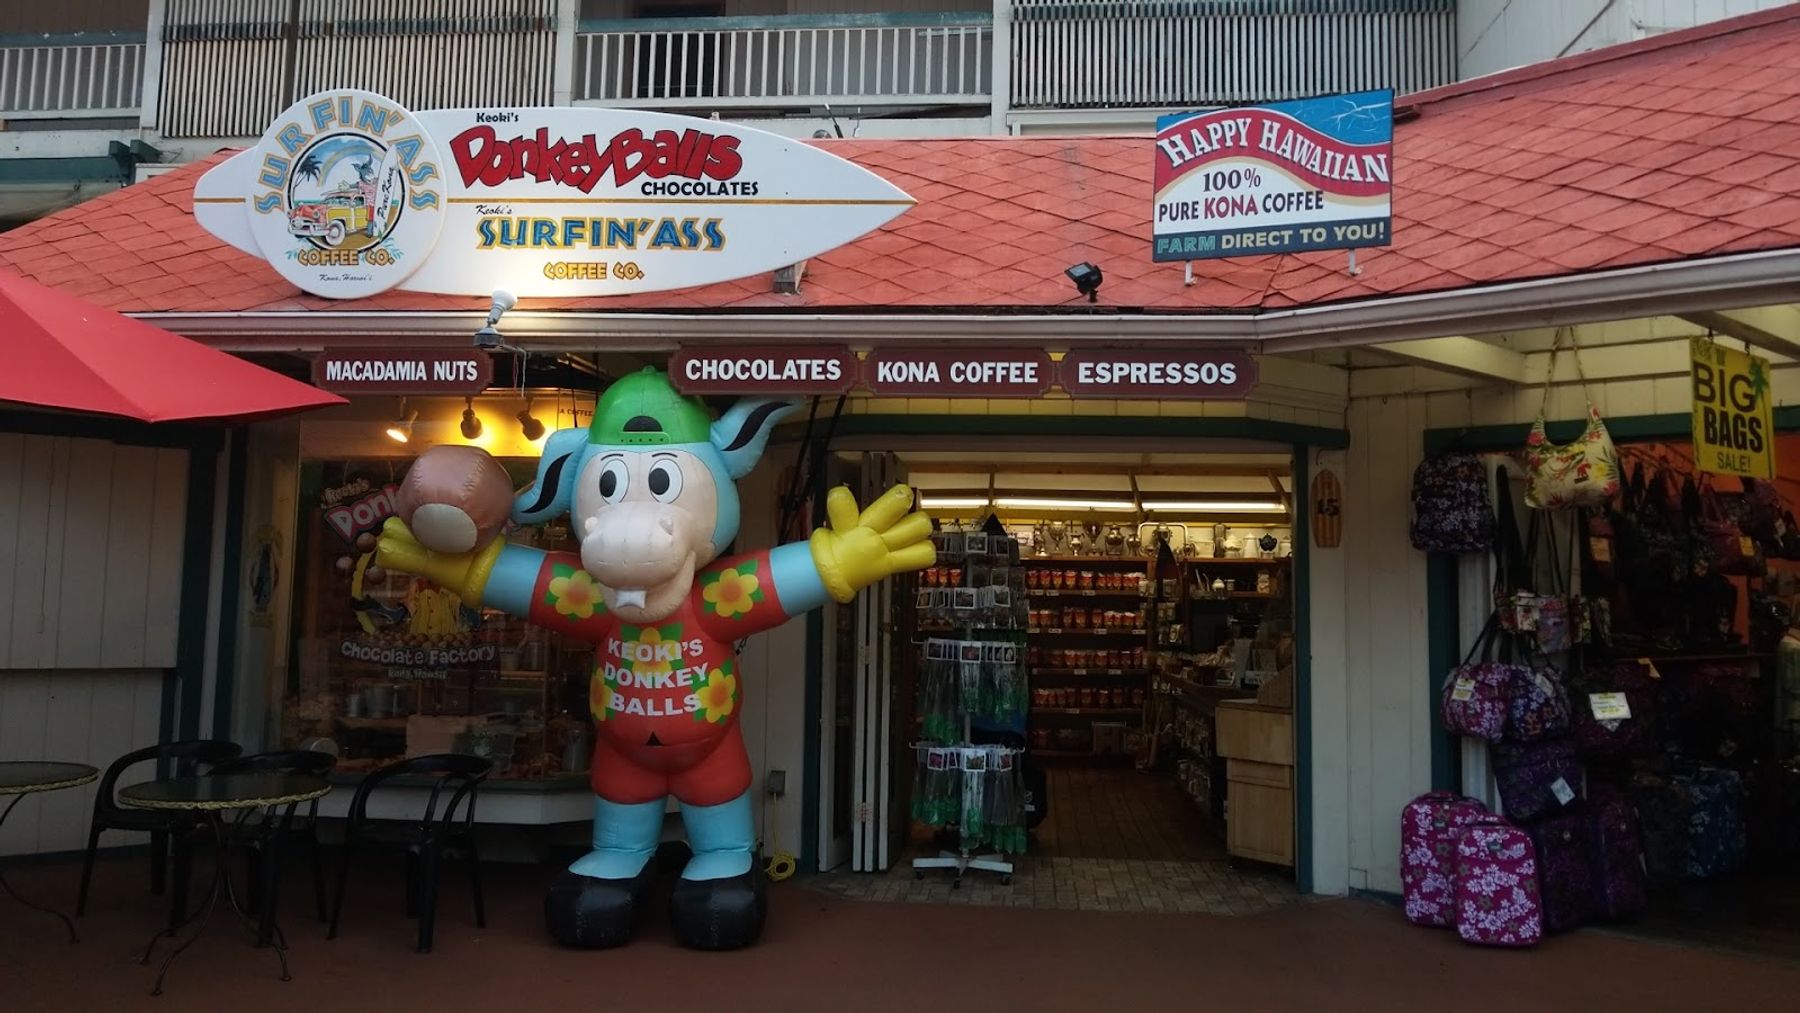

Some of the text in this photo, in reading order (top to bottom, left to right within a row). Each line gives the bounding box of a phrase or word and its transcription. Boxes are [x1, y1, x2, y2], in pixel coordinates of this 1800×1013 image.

[476, 112, 519, 123] Keoki's
[1156, 118, 1390, 183] HAPPY HAWAIIAN
[641, 181, 758, 196] CHOCOLATES
[1203, 167, 1261, 192] 100%
[475, 204, 513, 216] Keoki's
[1159, 190, 1324, 222] PURE KONA COFFEE
[1157, 221, 1385, 254] FARM DIRECT TO YOU!
[298, 249, 396, 266] COFFEE CO.
[543, 262, 645, 280] COFFEE CO.
[326, 359, 478, 382] MACADAMIA NUTS
[685, 358, 842, 382] CHOCOLATES
[877, 361, 1039, 384] KONA COFFEE
[1078, 361, 1238, 384] ESPRESSOS
[1692, 360, 1757, 413] BIG
[1703, 405, 1764, 454] BAGS
[1717, 452, 1751, 473] SALE!
[341, 641, 496, 665] Chocolate Factory
[608, 637, 704, 662] KEOKI'S
[604, 661, 709, 689] DONKEY
[608, 692, 702, 716] BALLS
